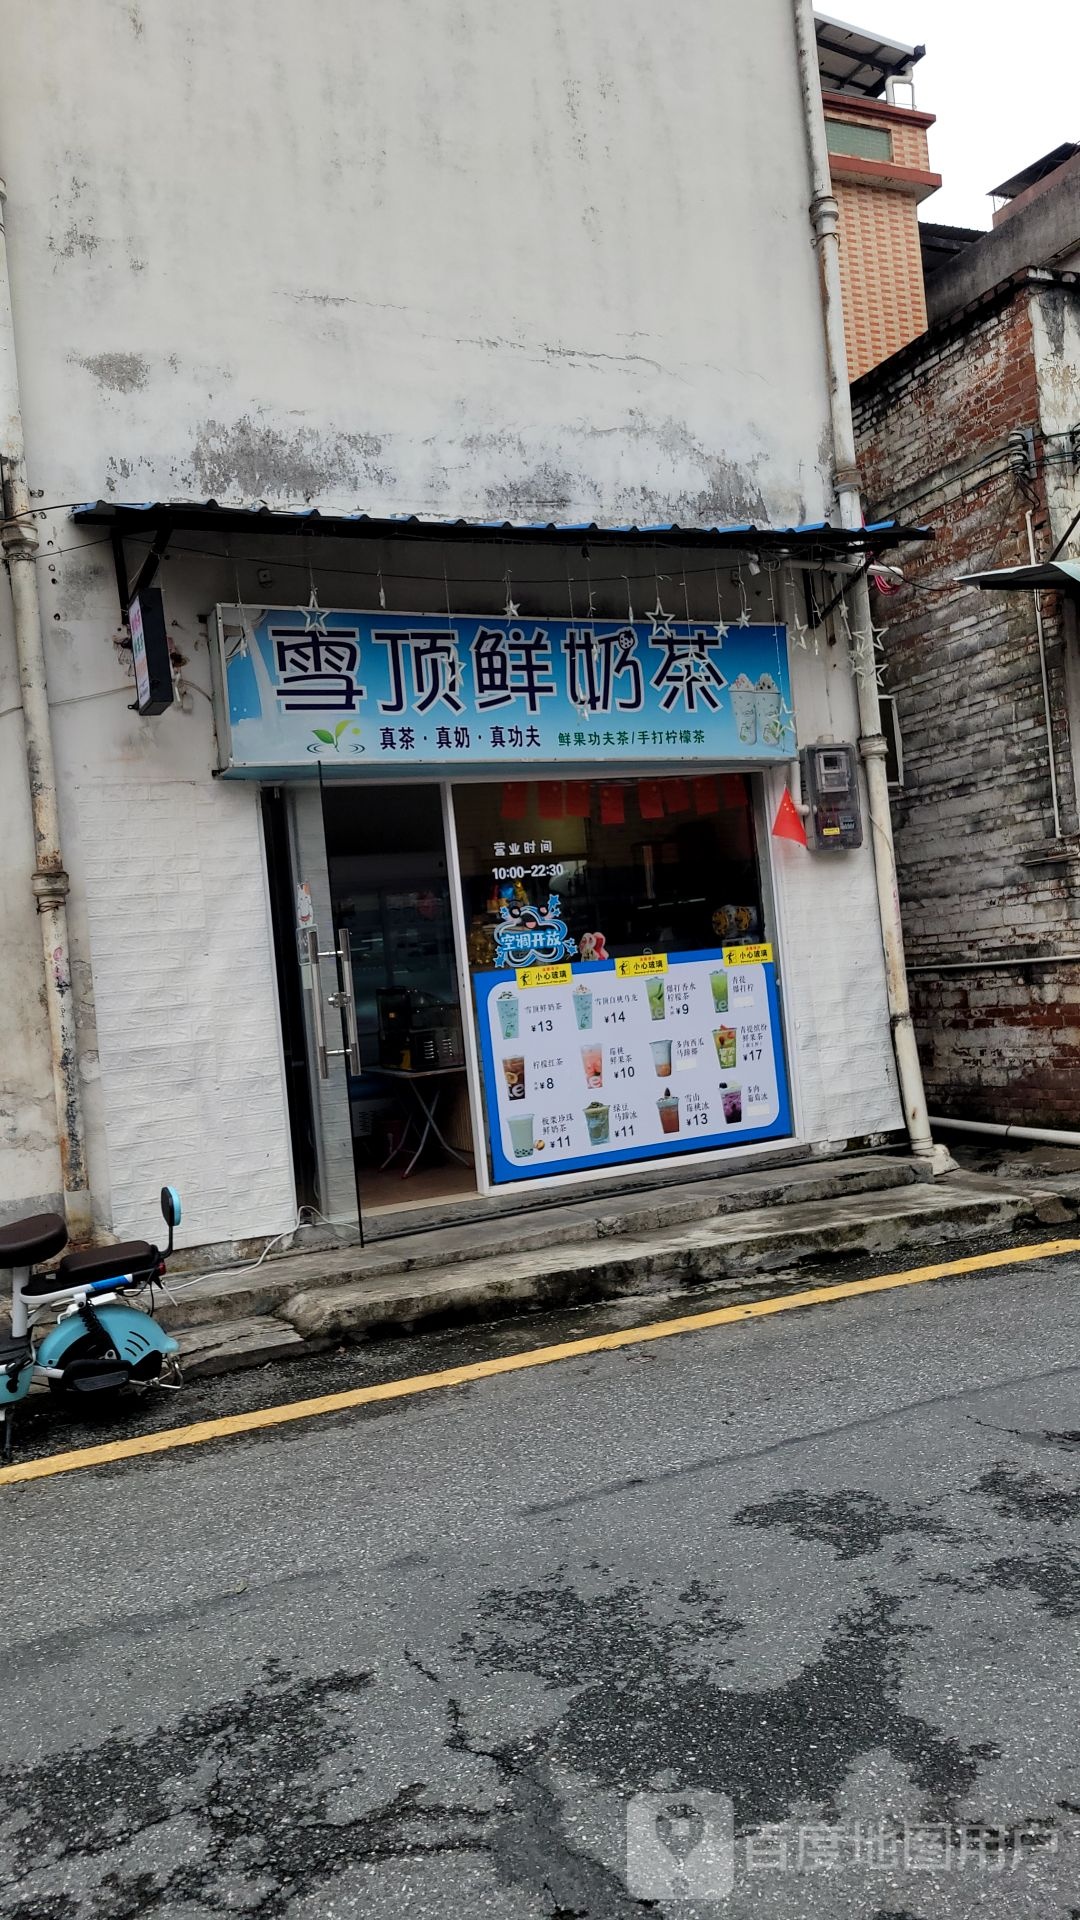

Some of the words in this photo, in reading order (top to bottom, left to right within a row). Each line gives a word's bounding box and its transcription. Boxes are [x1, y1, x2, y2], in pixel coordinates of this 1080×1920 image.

[268, 627, 728, 716] 雪顶鲜奶茶
[493, 840, 553, 857] 营业时间
[492, 863, 564, 880] 10:00-22:30
[500, 930, 561, 951] 空调开放
[739, 949, 768, 959] 小心玻璃
[633, 960, 663, 971] 小心玻璃
[535, 970, 567, 981] 小心玻璃
